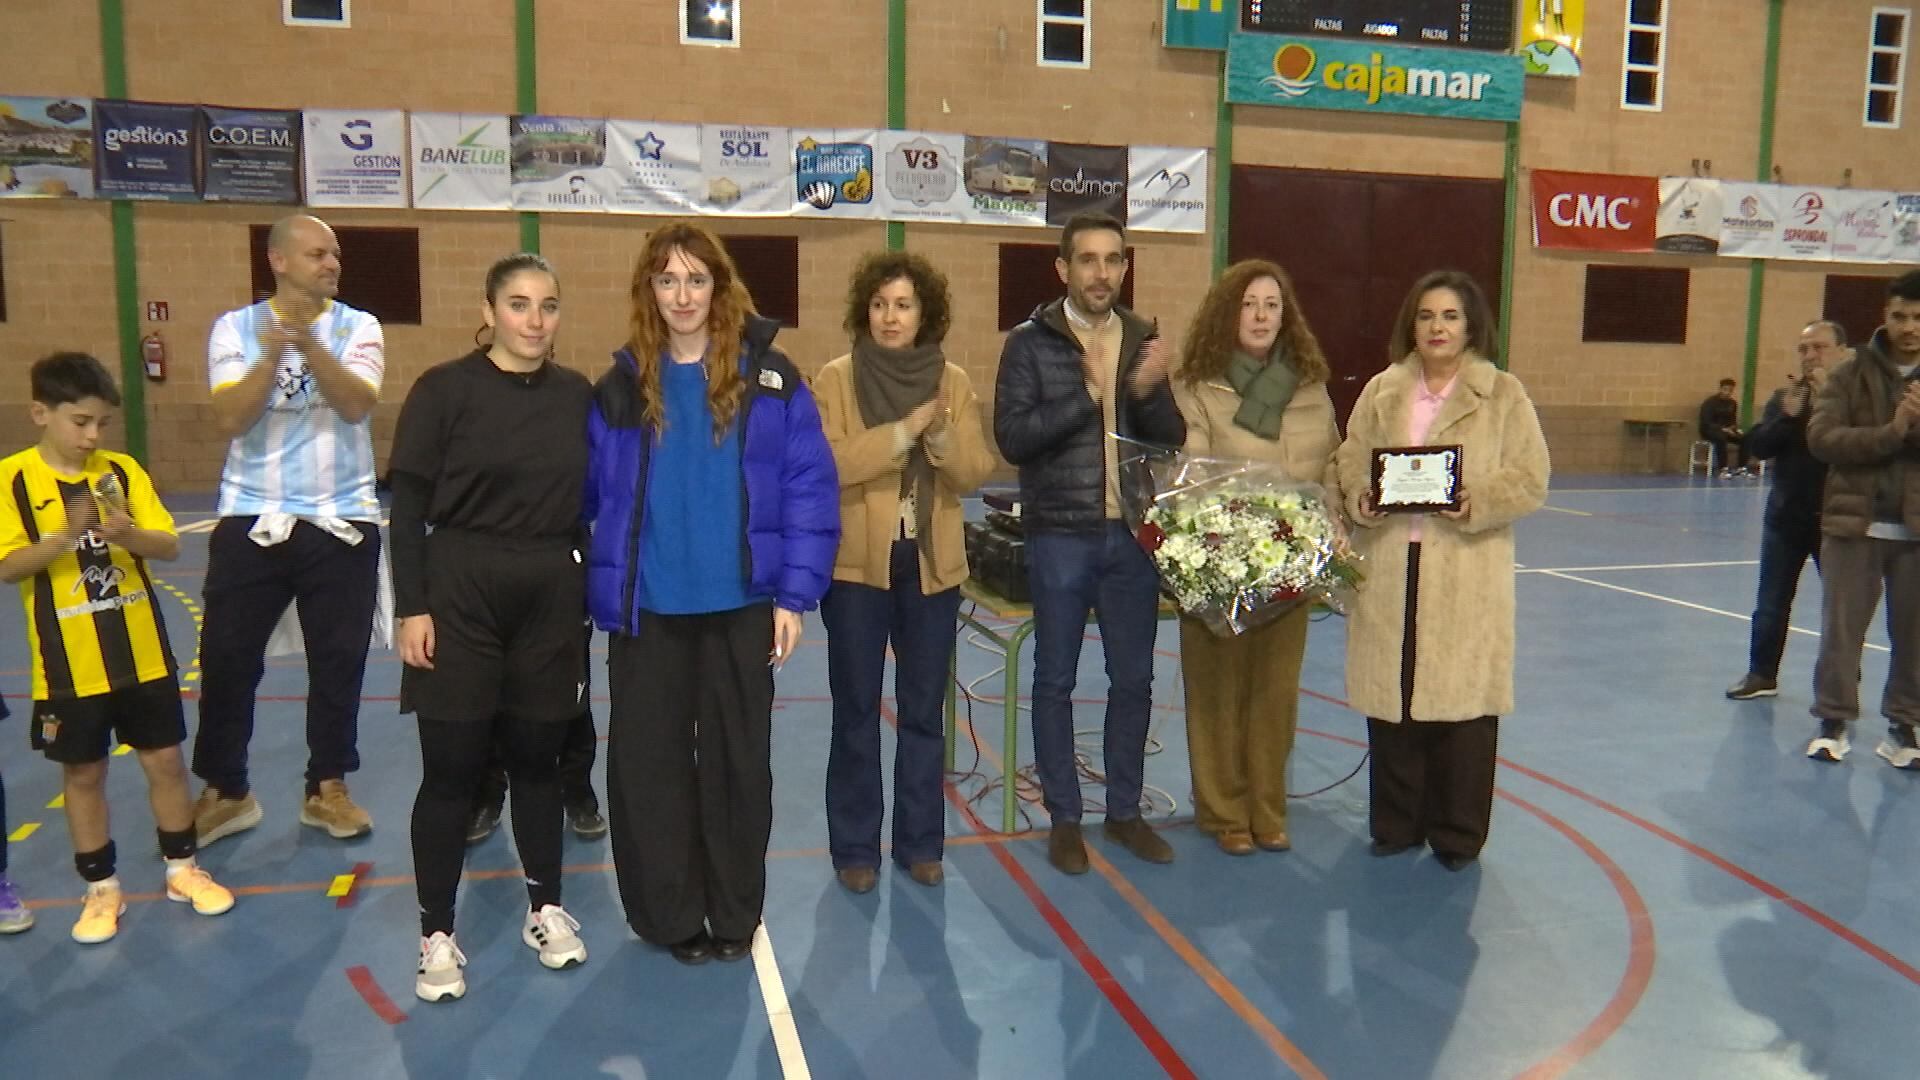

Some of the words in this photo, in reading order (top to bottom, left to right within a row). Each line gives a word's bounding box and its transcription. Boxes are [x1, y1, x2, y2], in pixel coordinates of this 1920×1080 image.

[1313, 18, 1342, 31] FALTAS
[1361, 23, 1398, 36] JUGADOR
[1420, 28, 1449, 41] FALTAS
[1322, 52, 1493, 105] cajamar
[104, 125, 189, 151] gestión3
[208, 126, 294, 148] C.O.E.M.
[420, 147, 506, 165] BANELUB
[722, 140, 769, 157] SOL
[800, 154, 814, 173] EL
[903, 149, 939, 170] V3
[1549, 192, 1633, 231] CMC
